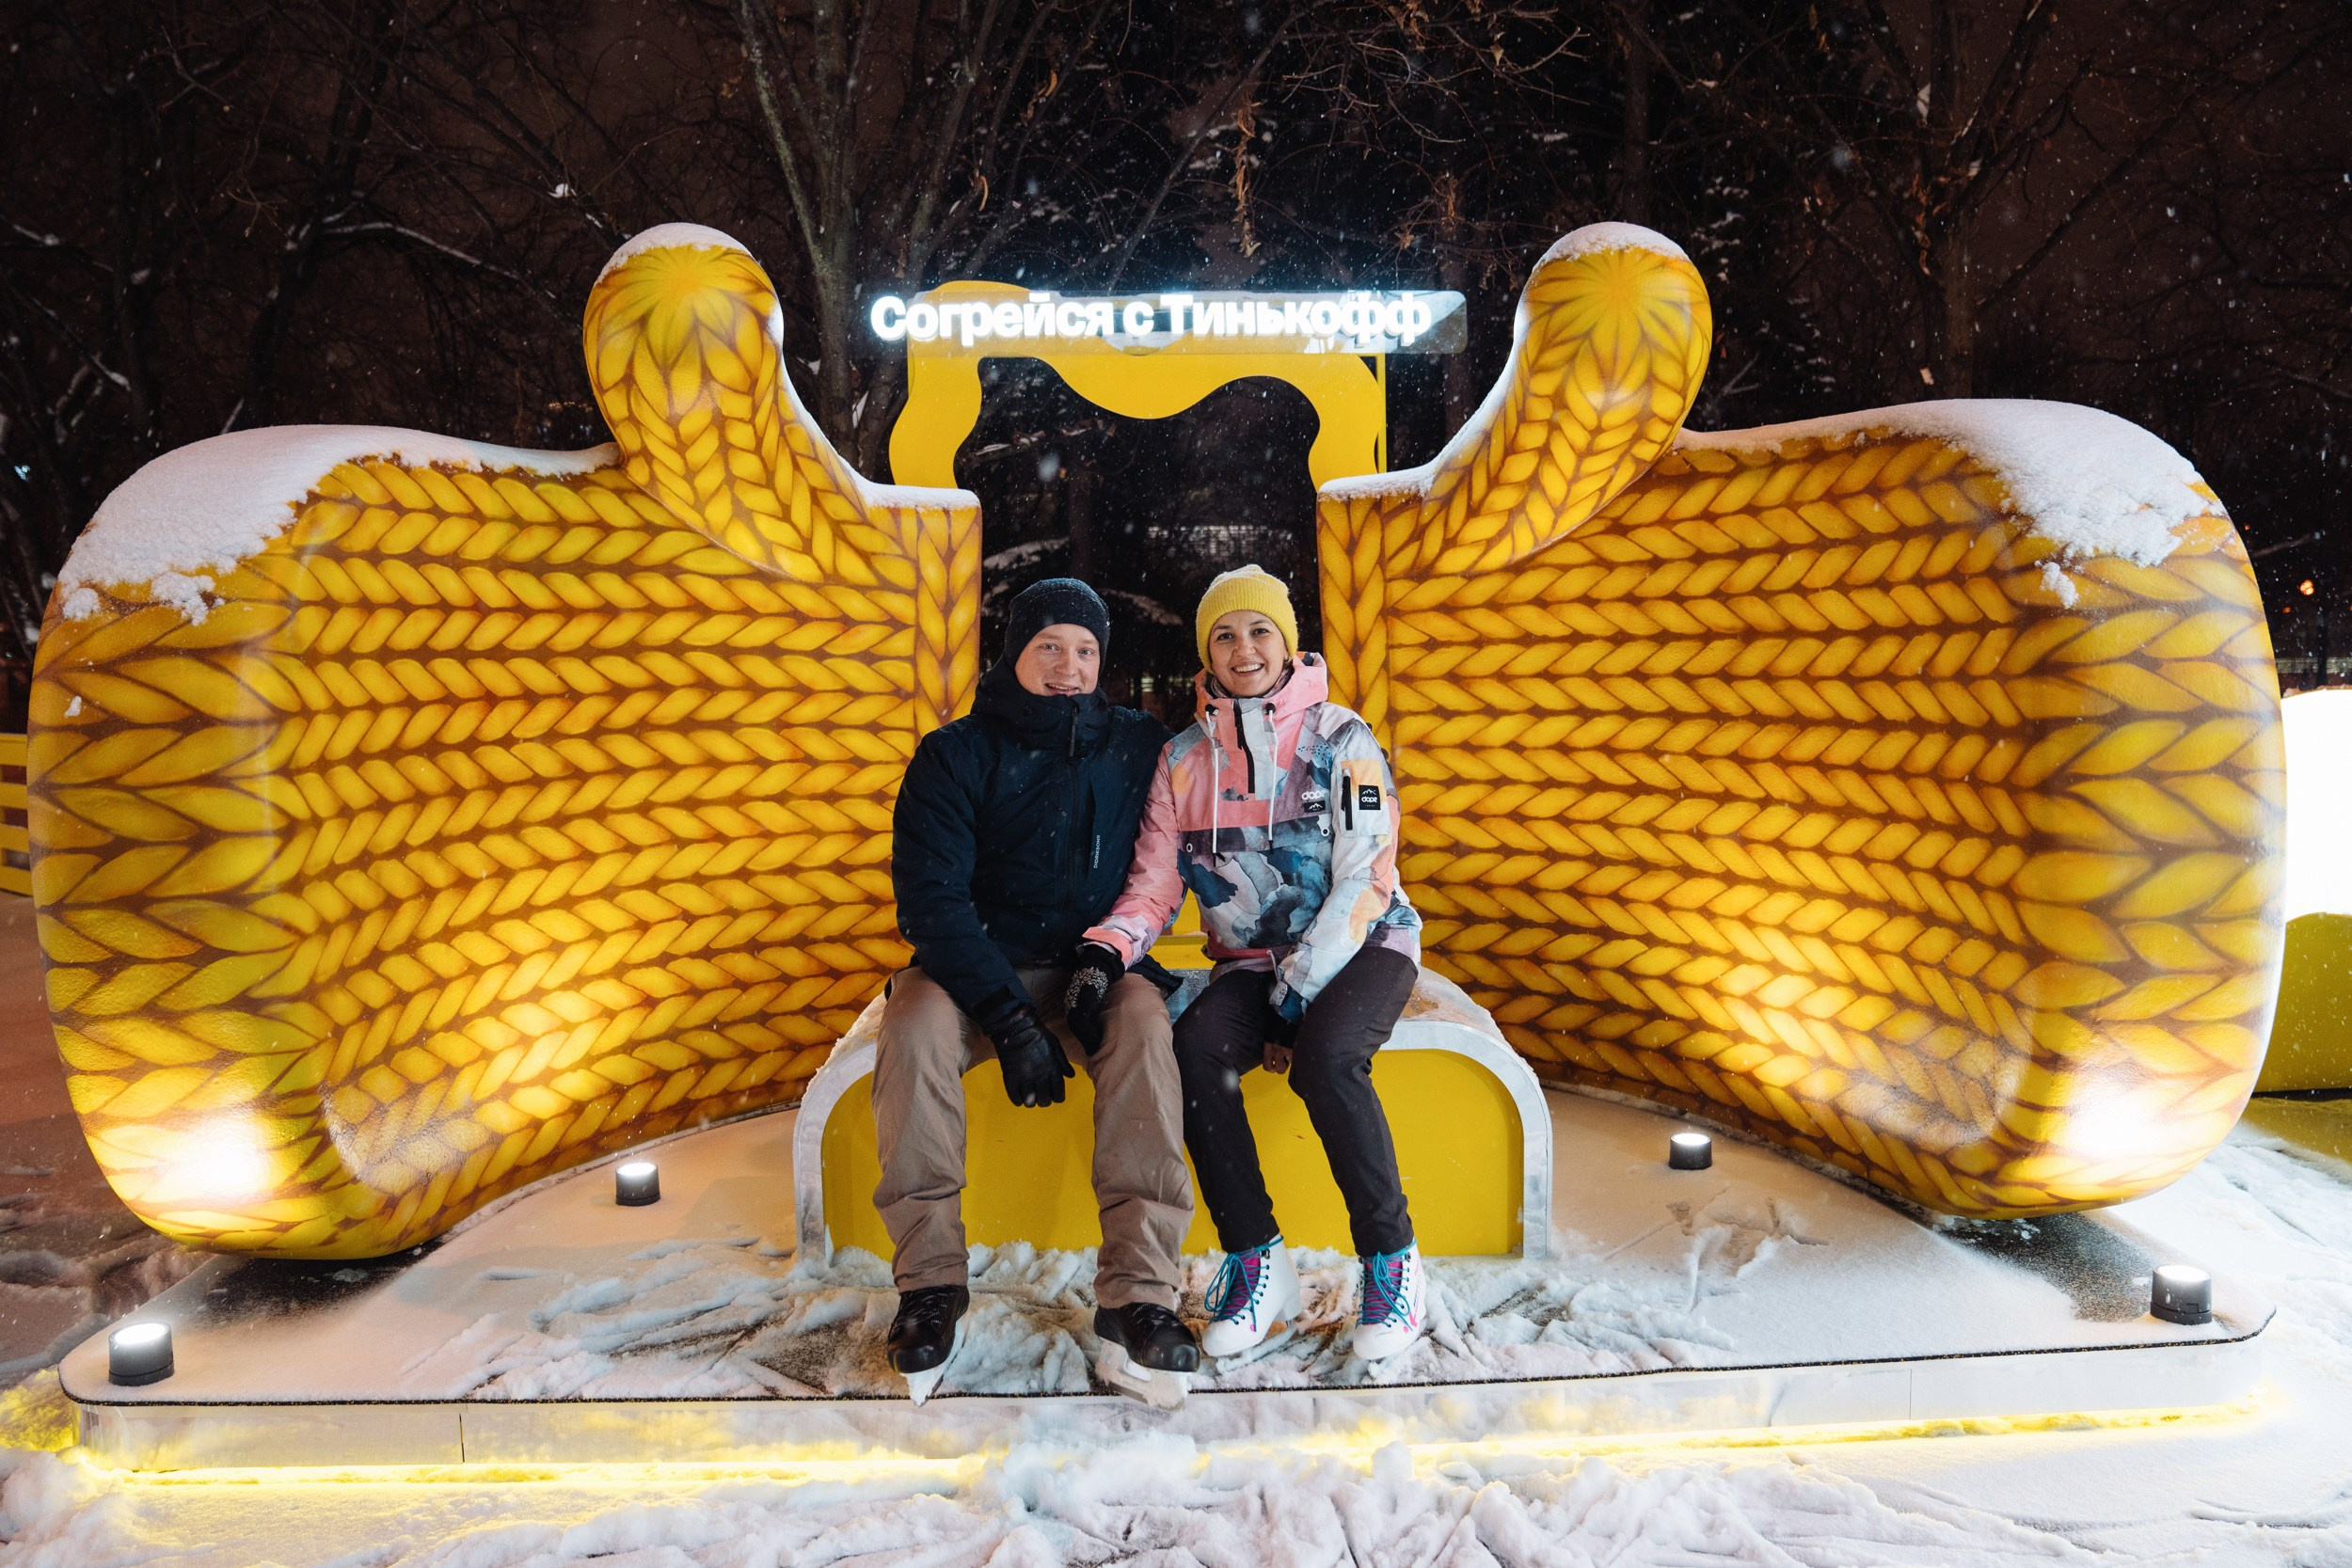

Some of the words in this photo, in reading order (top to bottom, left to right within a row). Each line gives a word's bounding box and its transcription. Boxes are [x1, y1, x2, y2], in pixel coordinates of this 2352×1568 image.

[870, 293, 1115, 347] Согрейся
[1122, 301, 1155, 338] с
[1160, 292, 1432, 347] Тинькофф
